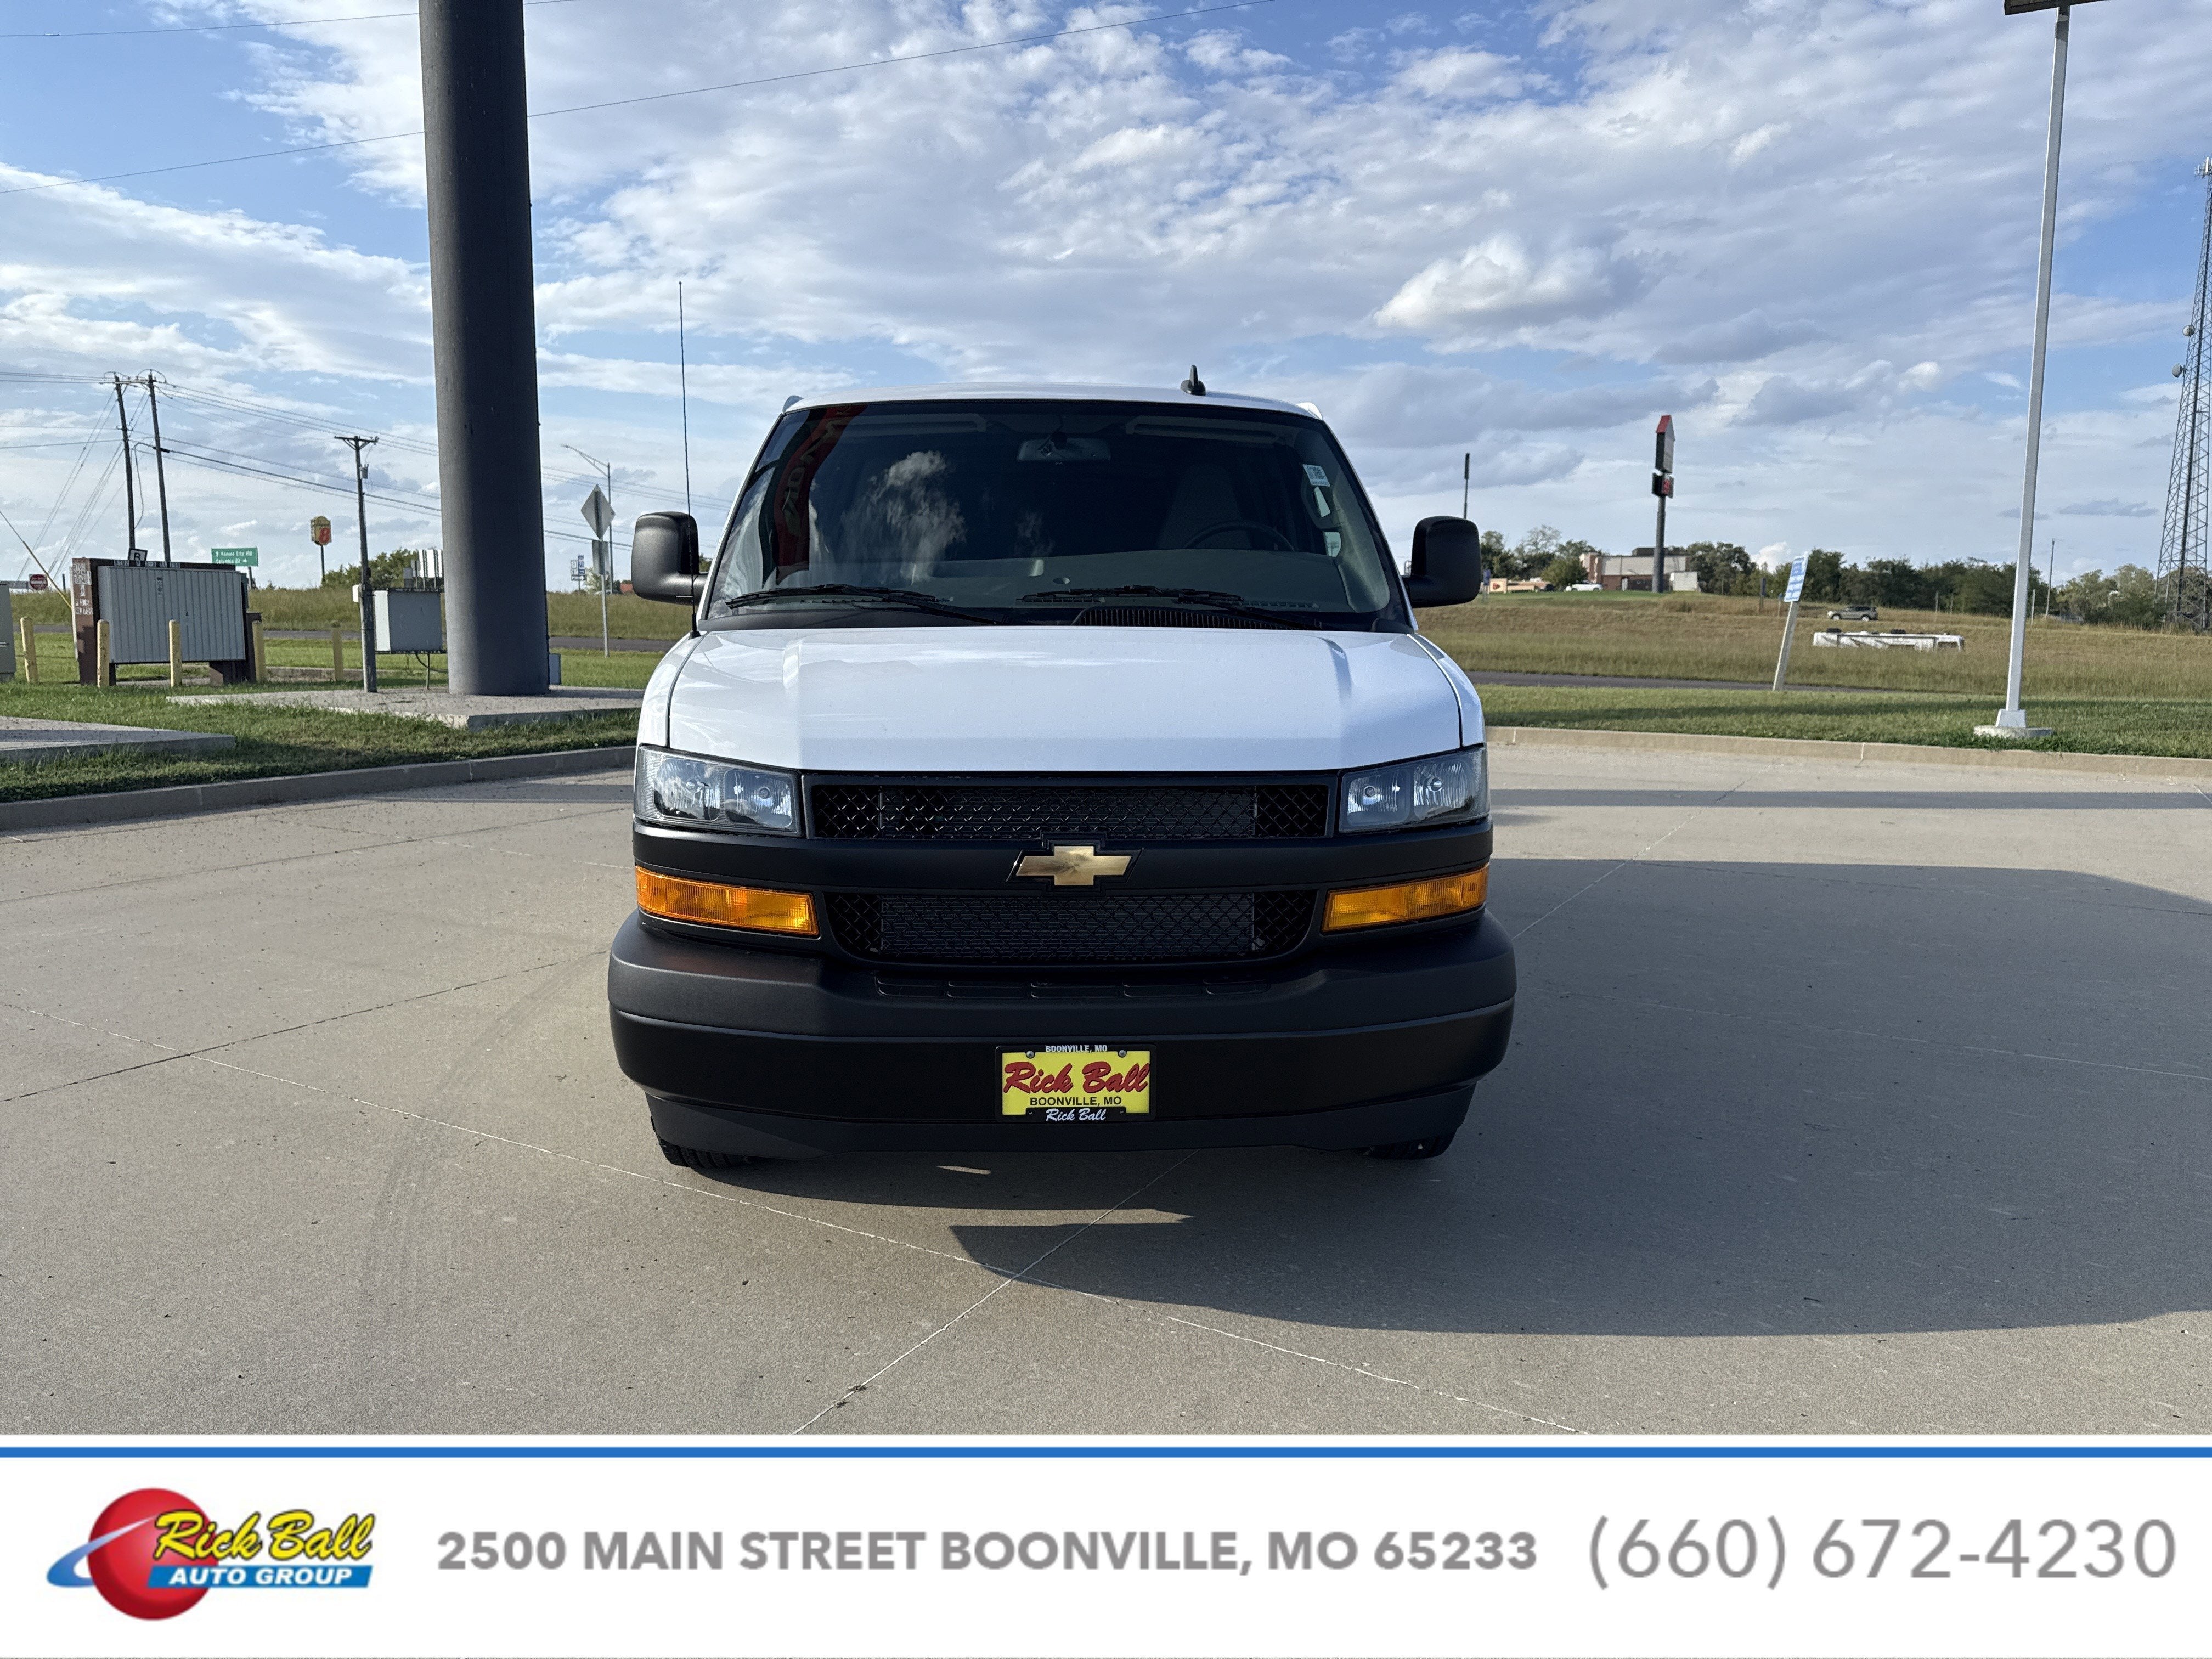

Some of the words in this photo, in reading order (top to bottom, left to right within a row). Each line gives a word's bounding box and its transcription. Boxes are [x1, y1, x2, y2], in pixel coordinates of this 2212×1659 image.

[319, 527, 330, 543] 8
[1045, 1045, 1092, 1053] BOONVILLE,
[1003, 1061, 1074, 1093] Rick
[1082, 1061, 1150, 1093] Ball
[1030, 1097, 1100, 1107] BOONVILLE,
[1104, 1096, 1122, 1105] MO
[1046, 1108, 1075, 1122] Rick
[1079, 1108, 1107, 1121] Ball
